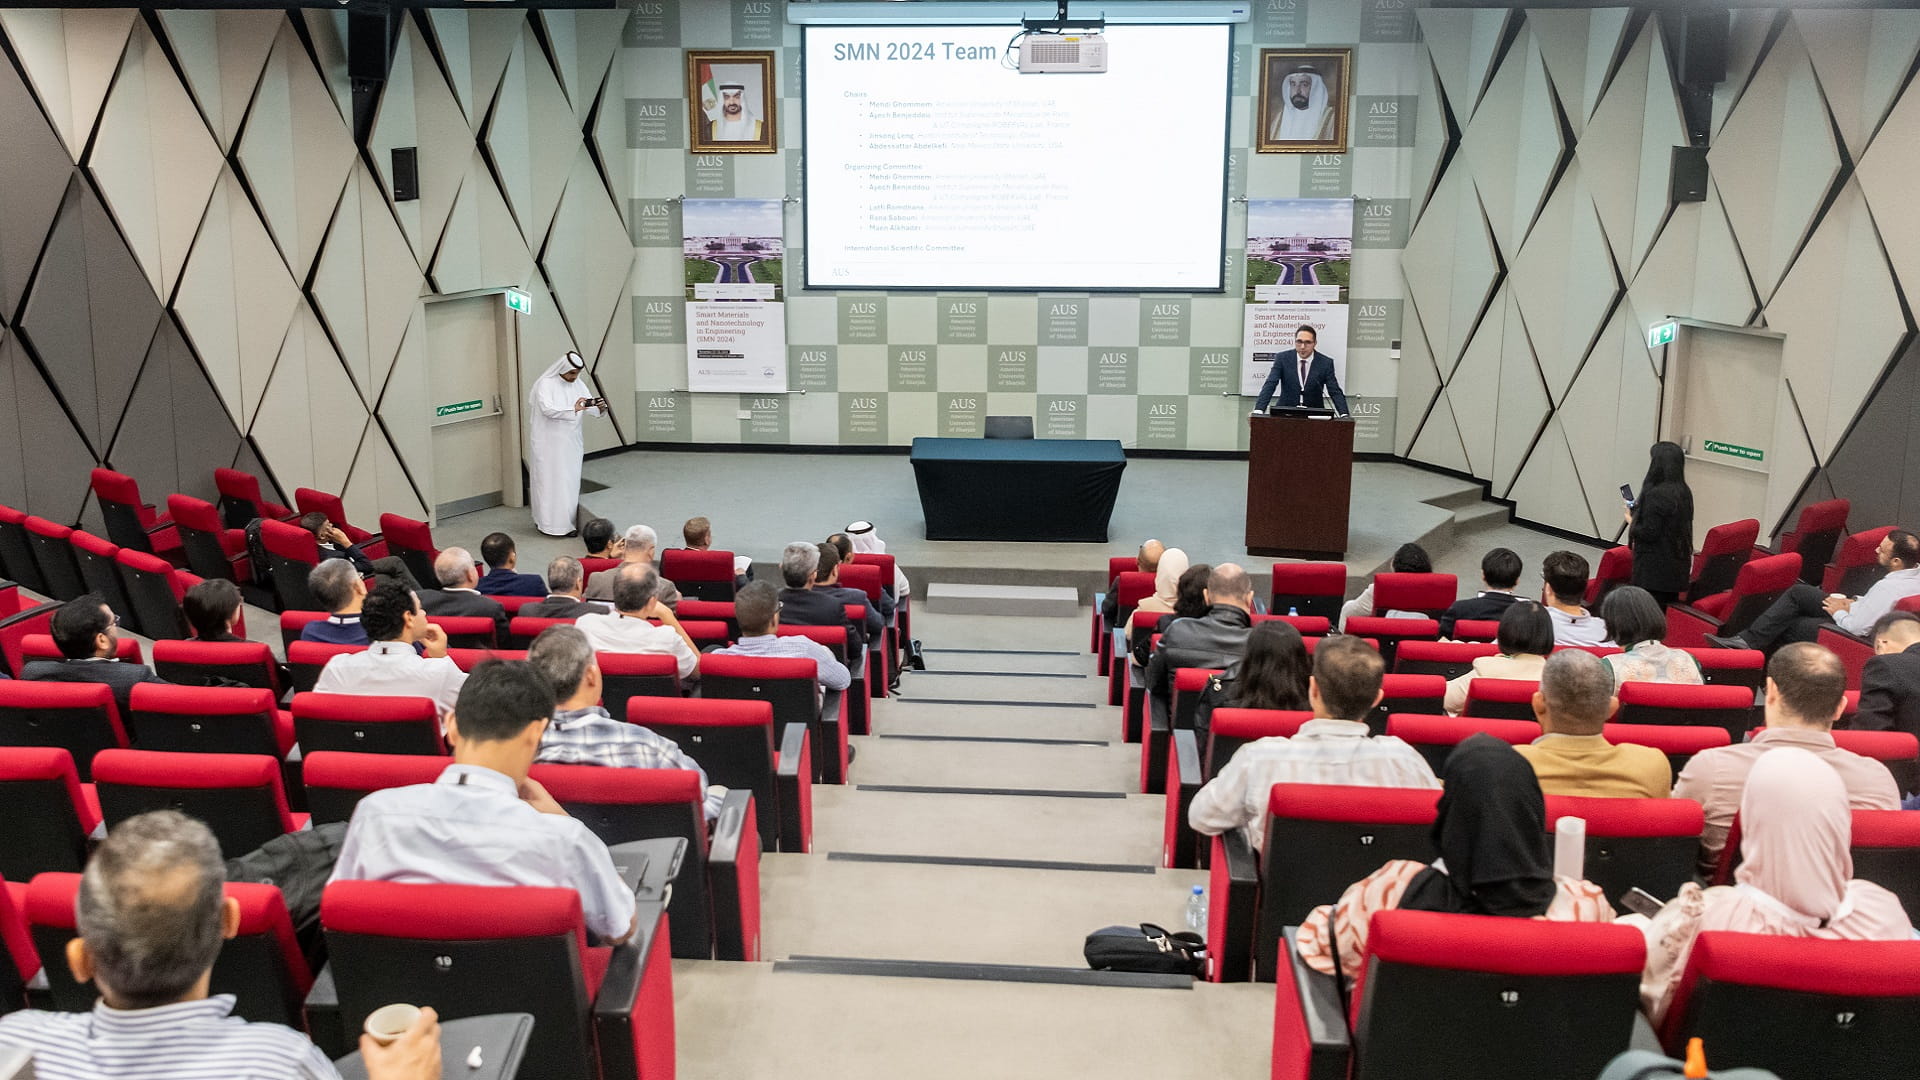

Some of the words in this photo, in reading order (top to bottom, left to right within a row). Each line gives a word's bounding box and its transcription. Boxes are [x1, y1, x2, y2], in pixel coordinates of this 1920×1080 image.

[635, 3, 663, 14] AUS
[744, 2, 771, 14] AUS
[1267, 0, 1296, 10] AUS
[834, 42, 880, 60] SMN
[887, 42, 936, 60] 2024
[942, 42, 996, 60] Team
[640, 105, 666, 116] AUS
[1369, 103, 1398, 114] AUS
[696, 156, 724, 166] AUS
[1312, 154, 1341, 166] AUS
[642, 205, 669, 216] AUS
[1364, 206, 1392, 216] AUS
[646, 302, 672, 313] AUS
[850, 304, 876, 314] AUS
[950, 304, 976, 314] AUS
[1050, 304, 1078, 315] AUS
[1152, 304, 1180, 315] AUS
[1359, 306, 1386, 316] AUS
[800, 352, 827, 362] AUS
[899, 351, 926, 362] AUS
[999, 352, 1026, 362] AUS
[1100, 353, 1128, 364] AUS
[1201, 354, 1229, 364] AUS
[649, 398, 676, 408] AUS
[752, 399, 779, 409] AUS
[851, 398, 877, 408] AUS
[949, 398, 976, 409] AUS
[1049, 401, 1076, 411] AUS
[1150, 405, 1177, 415] AUS
[1352, 404, 1381, 414] AUS
[1360, 836, 1374, 845] 17
[1837, 1012, 1855, 1023] 17
